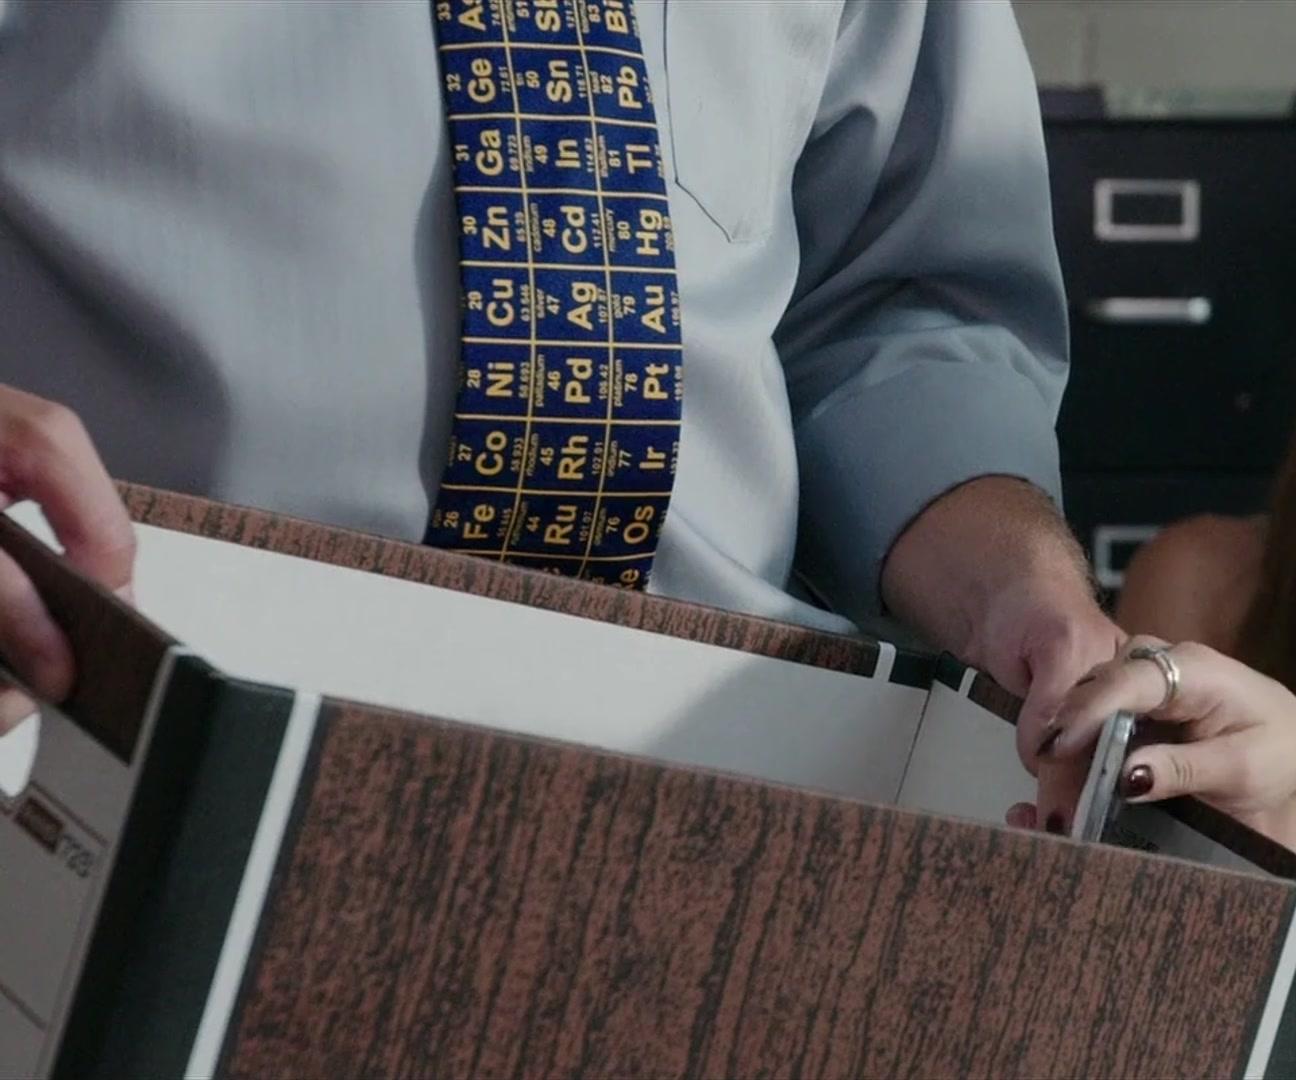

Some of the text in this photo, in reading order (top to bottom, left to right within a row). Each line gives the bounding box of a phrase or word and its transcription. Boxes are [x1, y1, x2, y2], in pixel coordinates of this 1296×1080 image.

[438, 2, 451, 21] 33
[517, 2, 530, 17] 51
[588, 4, 601, 22] 83
[605, 1, 628, 33] Bi
[447, 73, 461, 91] 32
[468, 58, 496, 103] Ge
[527, 71, 540, 88] 50
[546, 60, 573, 102] Sn
[602, 74, 613, 94] 82
[617, 66, 643, 109] Pb
[456, 144, 469, 161] 31
[476, 129, 504, 176] Ga
[535, 145, 548, 164] 49
[556, 139, 582, 168] In
[608, 150, 621, 167] 81
[463, 216, 477, 234] 30
[482, 206, 511, 250] Zn
[530, 203, 542, 252] cadmium
[543, 219, 556, 237] 48
[560, 205, 588, 254] Cd
[604, 209, 616, 252] mercury
[618, 221, 630, 240] 80
[635, 209, 663, 256] Hg
[468, 292, 482, 310] 29
[486, 279, 514, 326] Cu
[536, 288, 546, 318] silver
[548, 295, 560, 314] 47
[566, 281, 598, 330] Ag
[612, 294, 623, 319] gold
[623, 296, 636, 314] 79
[641, 286, 666, 333] Au
[467, 369, 481, 388] 28
[485, 362, 514, 397] Ni
[534, 354, 546, 407] palladium
[548, 371, 560, 391] 46
[564, 358, 593, 403] Pd
[613, 359, 624, 407] platinum
[624, 373, 638, 392] 78
[643, 363, 669, 400] Pt
[458, 444, 472, 461] 27
[474, 431, 506, 475] Co
[525, 433, 539, 476] rhodium
[540, 447, 555, 466] 45
[557, 436, 589, 480] Rh
[606, 440, 618, 477] iridium
[618, 450, 632, 467] 77
[638, 446, 666, 470] Ir
[443, 511, 459, 528] 26
[462, 504, 494, 539] Fe
[526, 516, 541, 532] 44
[544, 505, 577, 545] Ru
[605, 517, 621, 533] 76
[622, 505, 655, 544] Os
